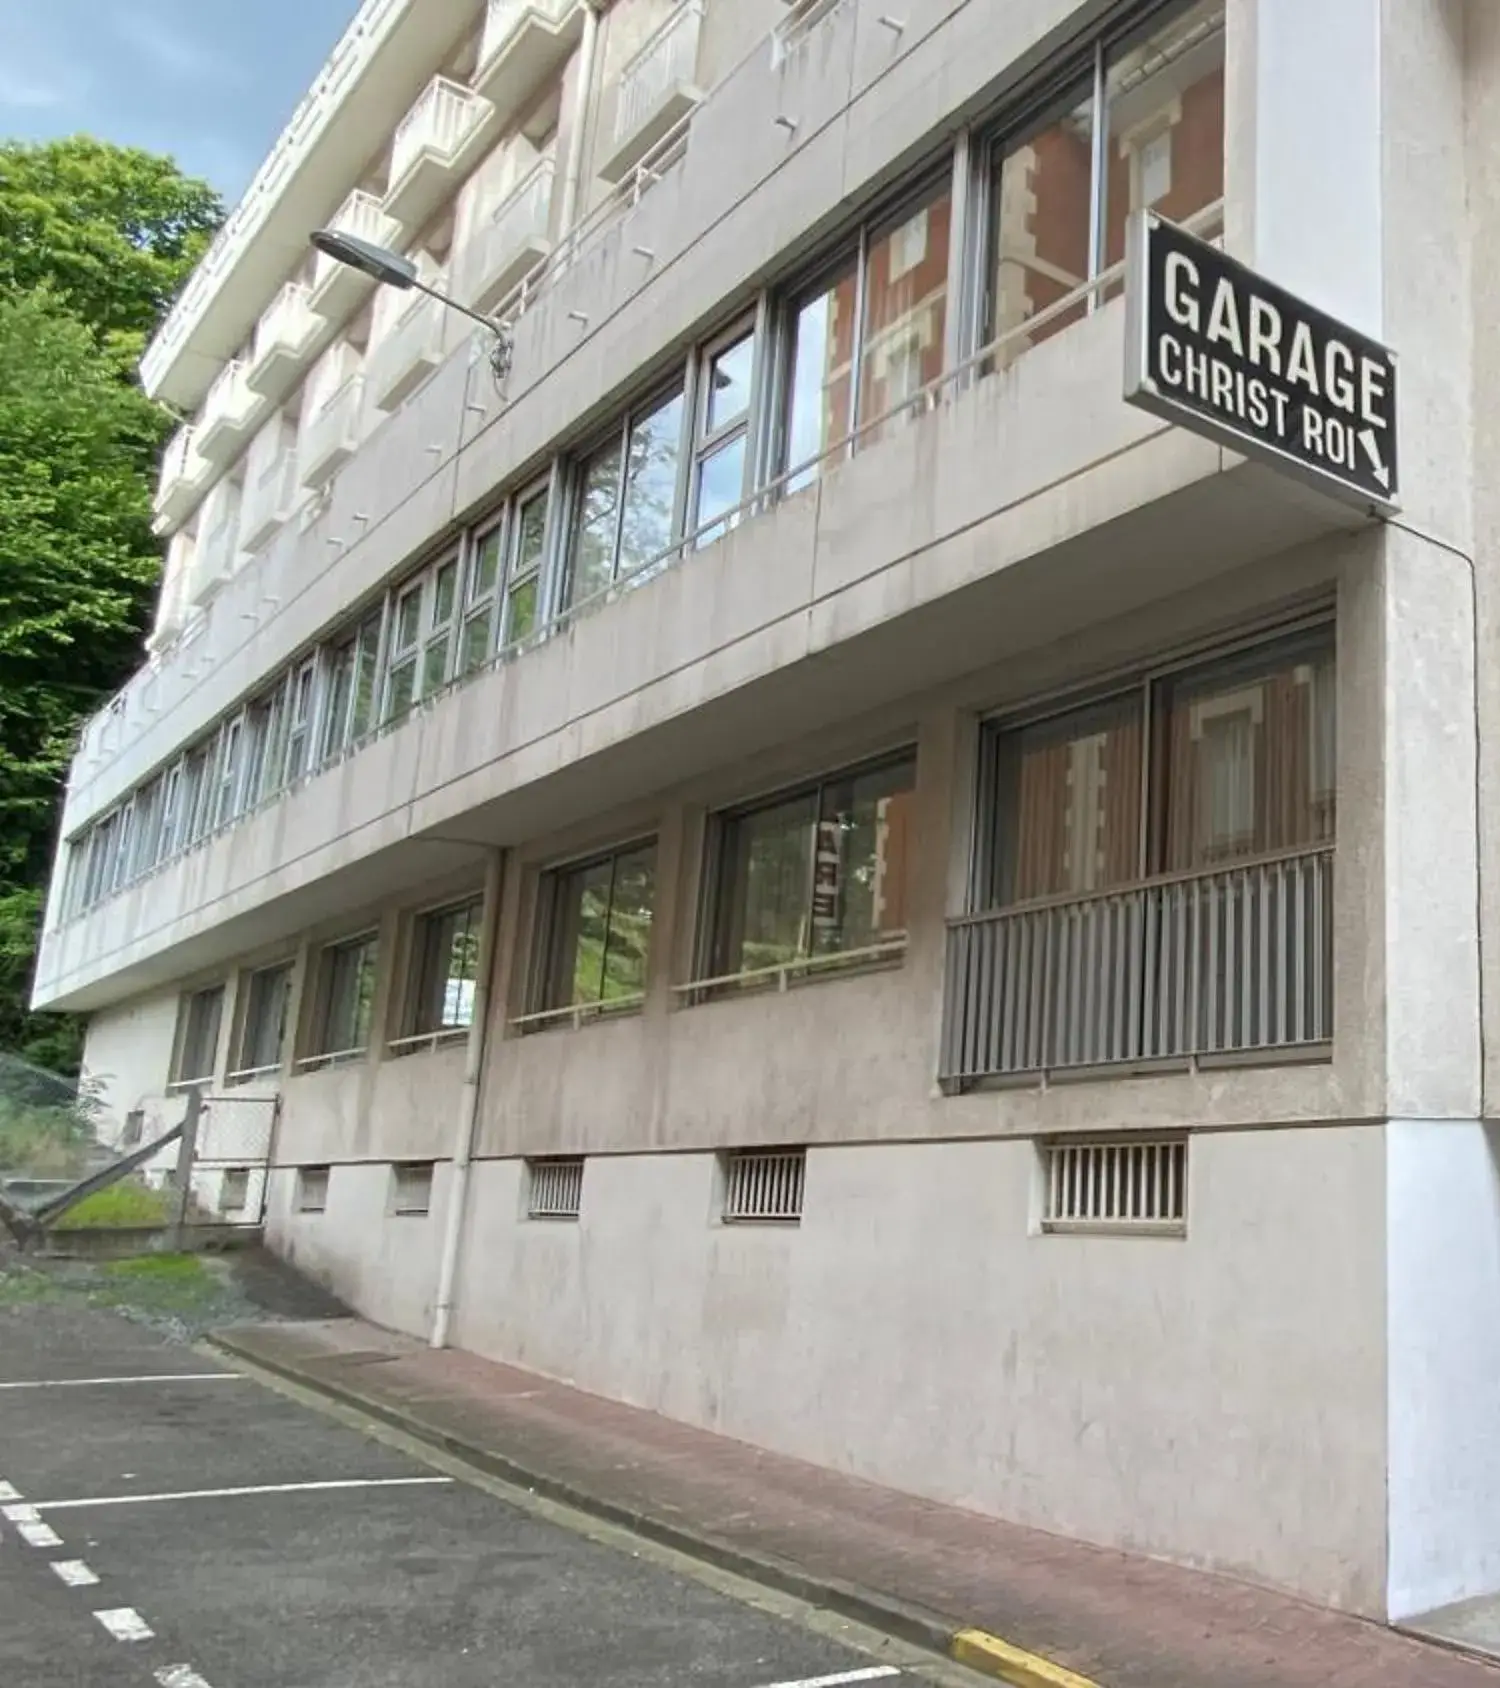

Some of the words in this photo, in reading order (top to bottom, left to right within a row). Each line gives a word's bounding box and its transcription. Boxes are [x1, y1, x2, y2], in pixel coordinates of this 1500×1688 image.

[1159, 333, 1289, 437] CHRIST
[1302, 403, 1356, 471] ROI
[1164, 251, 1387, 429] GARAGE
